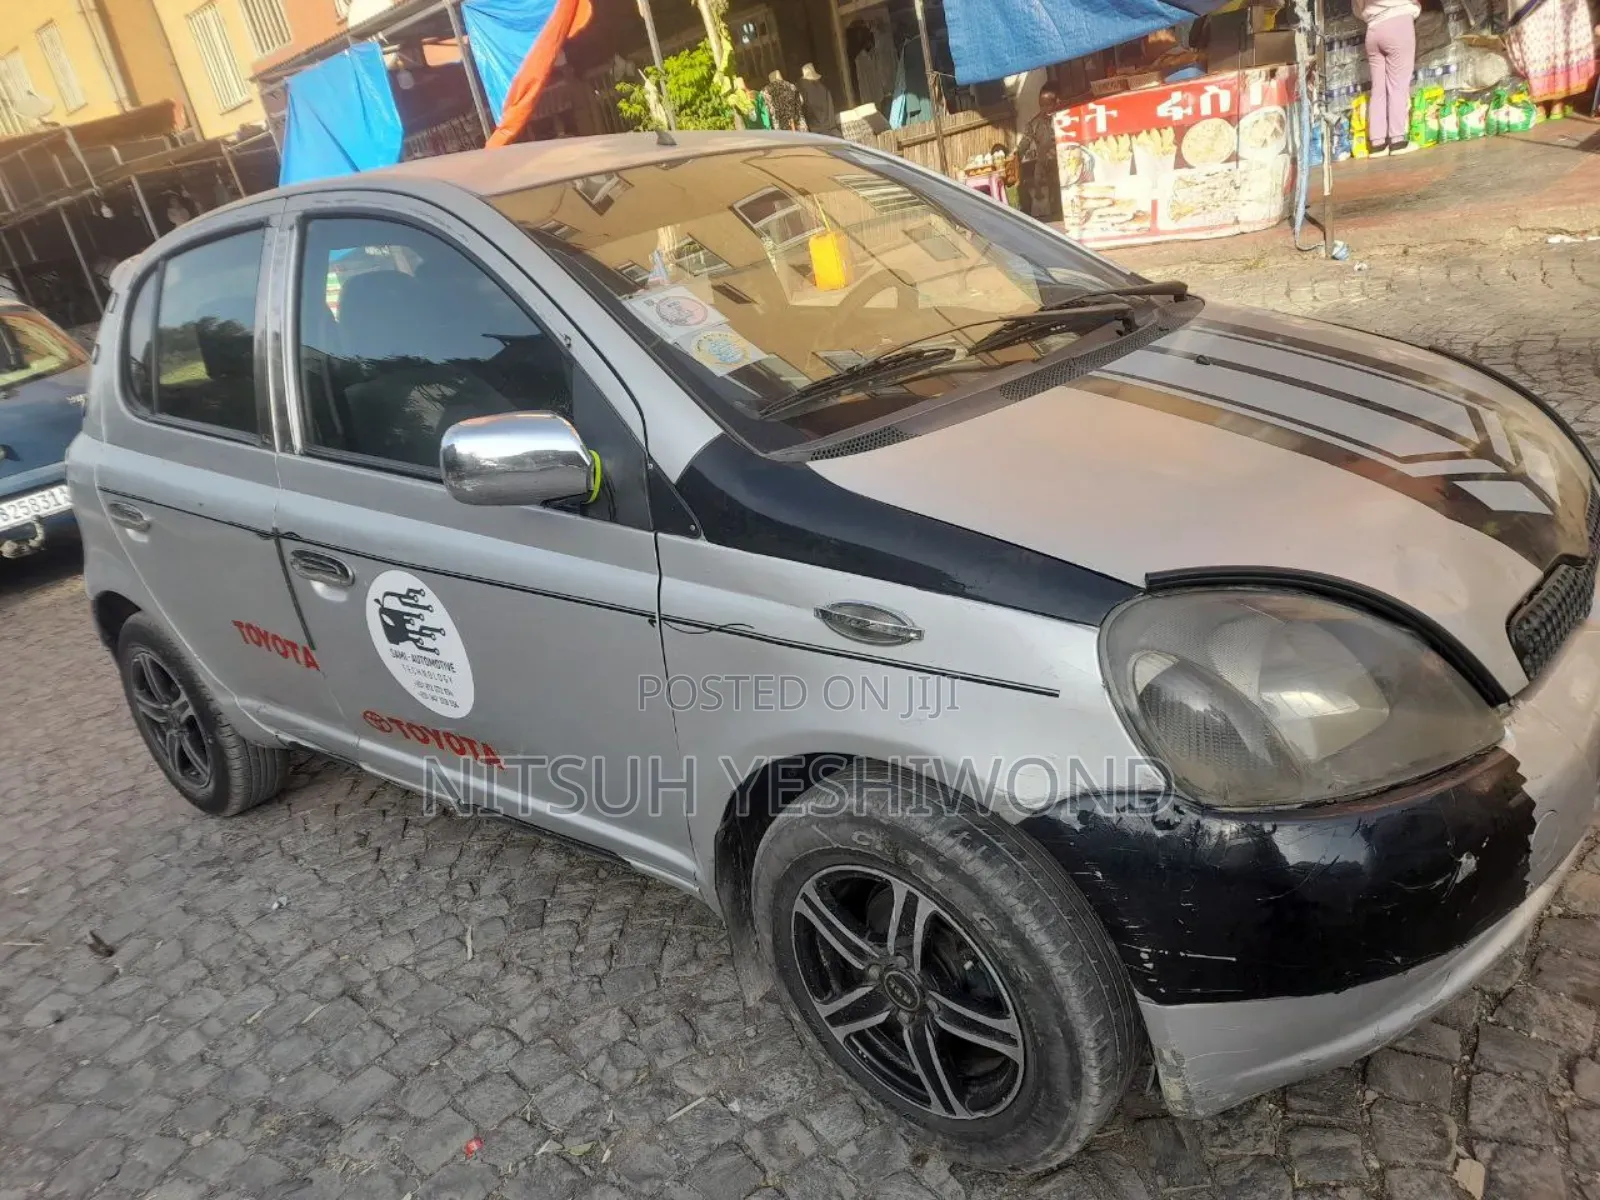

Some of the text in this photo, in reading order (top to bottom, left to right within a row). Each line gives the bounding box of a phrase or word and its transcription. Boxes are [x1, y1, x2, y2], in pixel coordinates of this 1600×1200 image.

[230, 620, 321, 672] TOYOTA
[401, 663, 454, 685] TECHNOLOGY
[387, 716, 505, 770] TOYOTA
